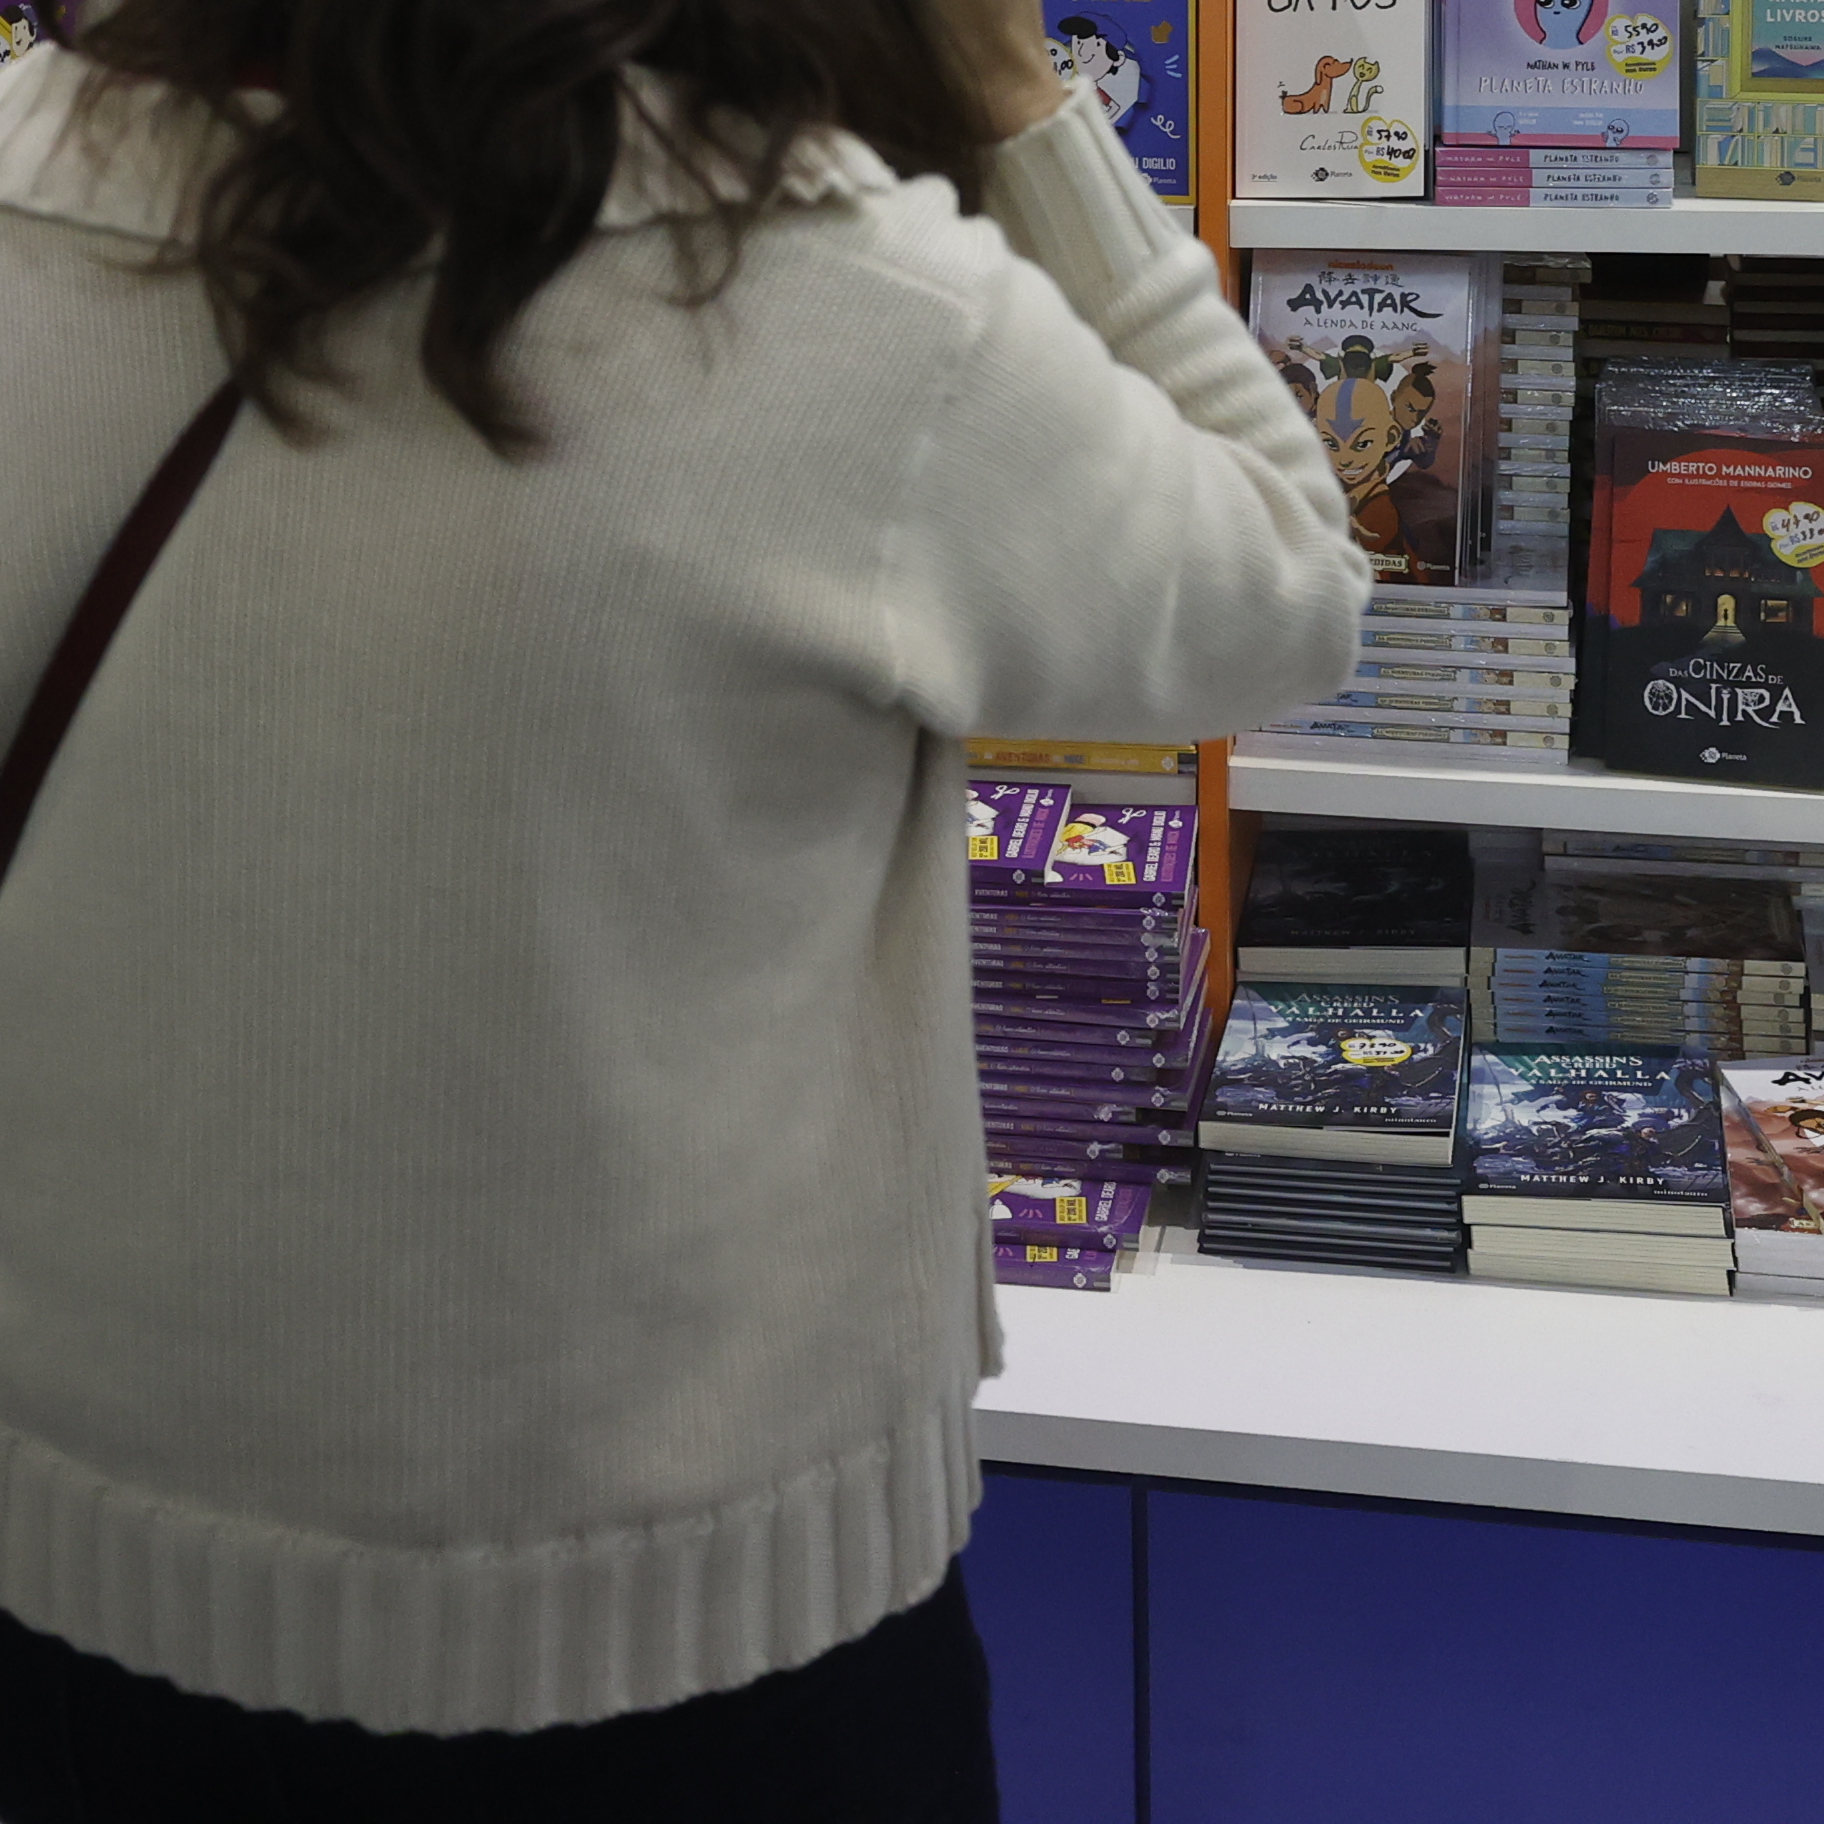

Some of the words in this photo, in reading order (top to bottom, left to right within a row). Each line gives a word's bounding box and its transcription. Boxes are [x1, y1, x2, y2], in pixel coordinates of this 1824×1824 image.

[1526, 60, 1559, 72] NATHAN
[1574, 59, 1596, 72] PYLE
[1478, 76, 1554, 95] PLANETA
[1561, 76, 1645, 96] ESTRANHO
[1285, 283, 1444, 319] AVATAR
[1303, 318, 1314, 327] A
[1316, 318, 1356, 330] LENDA
[1361, 319, 1375, 330] DE
[1380, 321, 1420, 333] AANG
[1648, 460, 1717, 476] UMBERTO
[1721, 462, 1813, 480] MANNARINO
[1669, 666, 1688, 677] DAS
[1688, 657, 1766, 682] CINZAS
[1768, 673, 1784, 685] DE
[1643, 678, 1807, 729] ONIRA
[1520, 1174, 1592, 1184] MATTHEW
[1618, 1174, 1665, 1186] KIRBY
